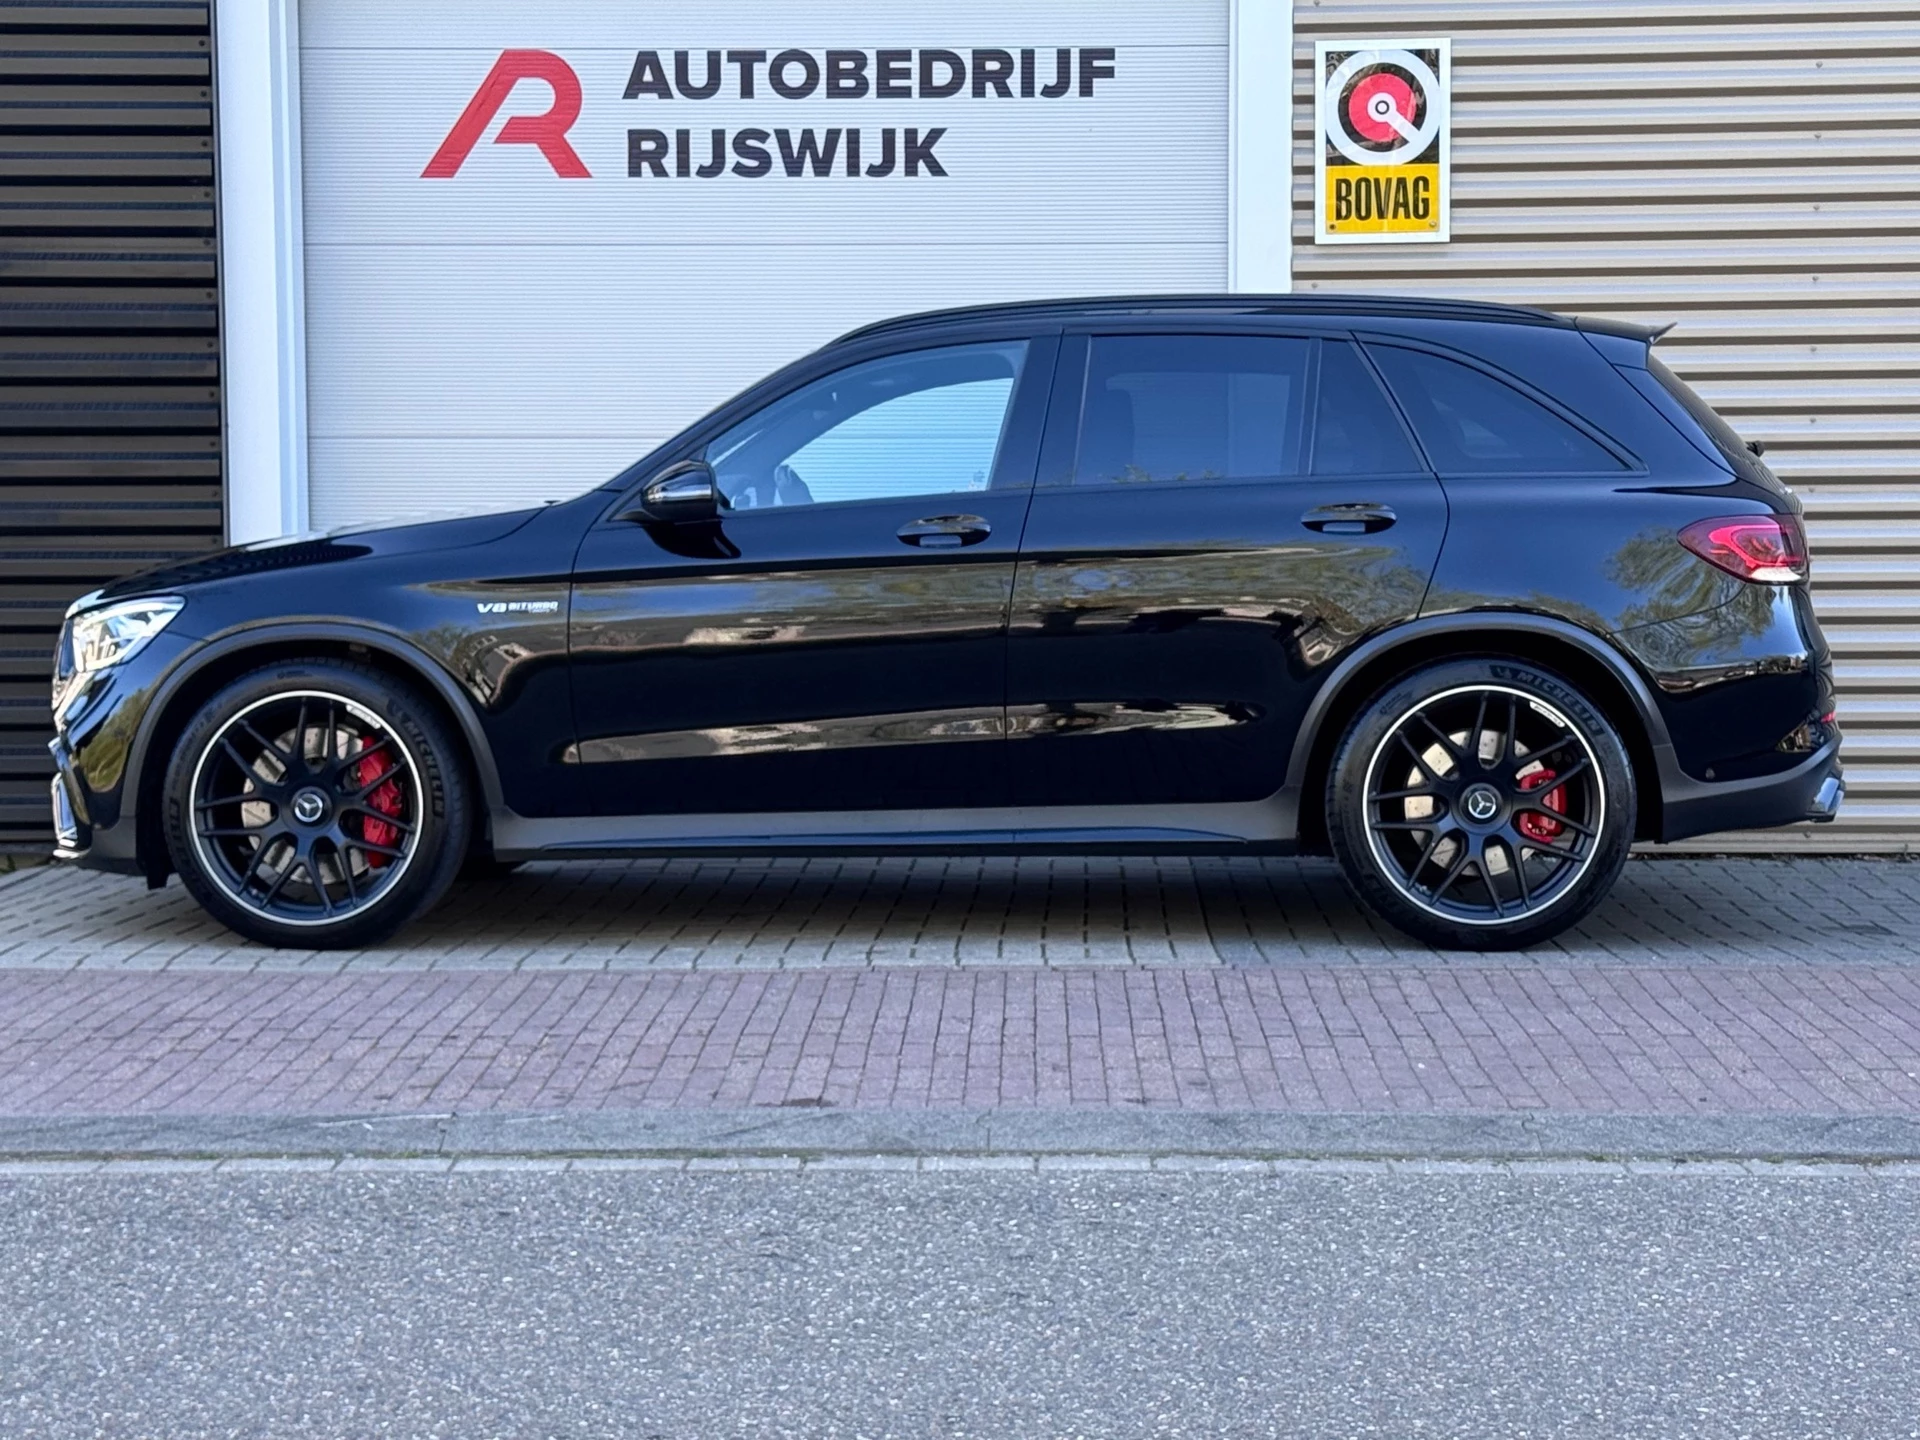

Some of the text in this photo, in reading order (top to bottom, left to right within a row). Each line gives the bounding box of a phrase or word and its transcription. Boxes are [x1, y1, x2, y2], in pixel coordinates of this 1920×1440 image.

[622, 47, 1115, 99] AUTOBEDRIJF
[627, 127, 948, 178] RIJSWIJK
[1335, 176, 1430, 221] BOVAG
[477, 602, 507, 613] V8
[1516, 671, 1602, 733] MICHELIN
